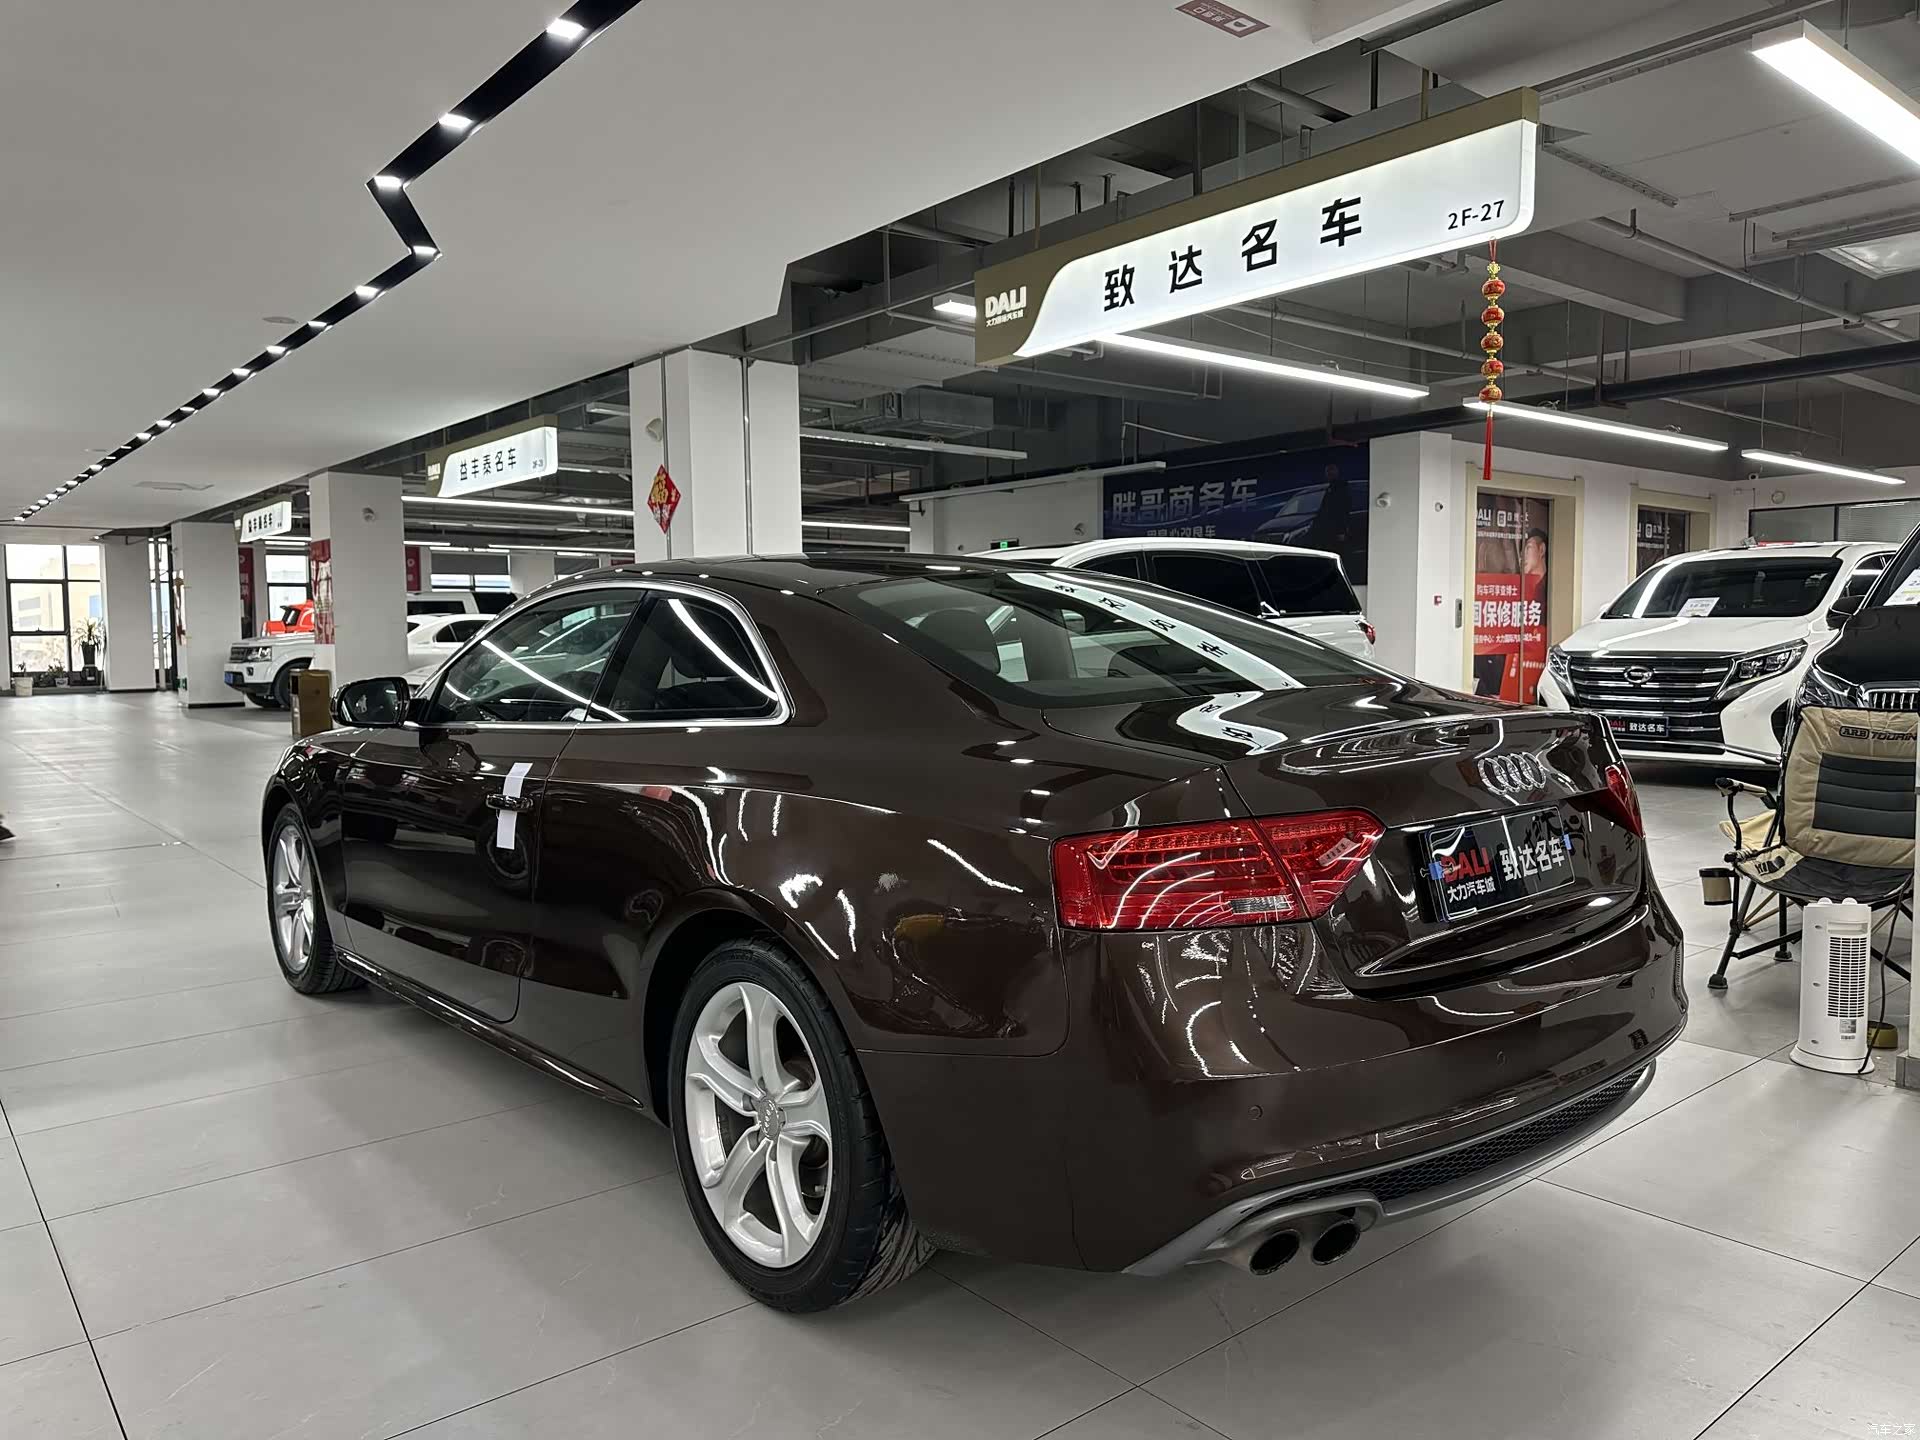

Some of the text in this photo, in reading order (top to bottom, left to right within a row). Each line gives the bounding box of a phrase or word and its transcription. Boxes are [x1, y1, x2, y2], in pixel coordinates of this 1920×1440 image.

[1448, 200, 1504, 230] 2F-27
[1104, 197, 1362, 312] 致达名车
[985, 286, 1026, 318] DALI
[1112, 478, 1258, 521] 胖哥商务车
[1474, 508, 1491, 521] ALI
[1629, 722, 1665, 733] 致达名车
[1843, 728, 1867, 737] ARB
[1500, 837, 1566, 882] 致达名车
[1447, 876, 1496, 904] 大力汽车城
